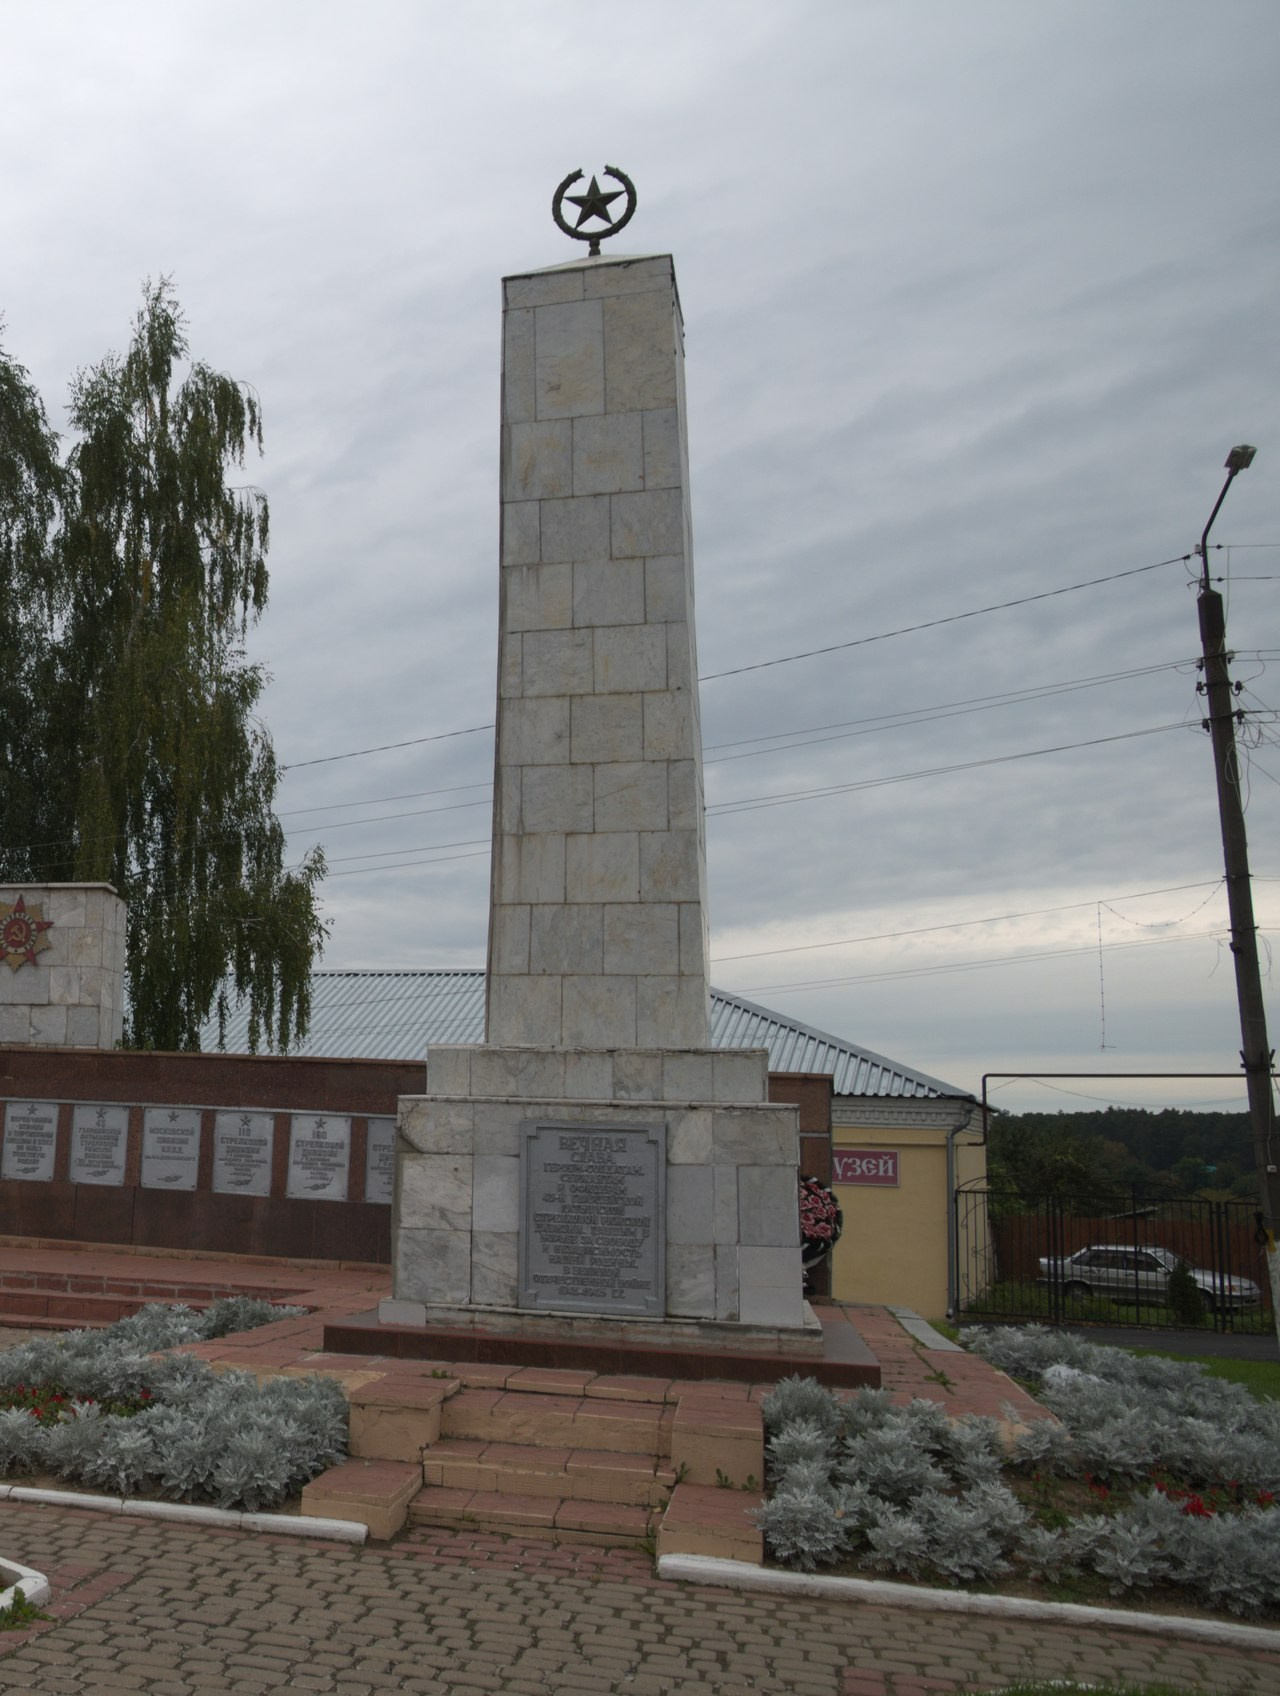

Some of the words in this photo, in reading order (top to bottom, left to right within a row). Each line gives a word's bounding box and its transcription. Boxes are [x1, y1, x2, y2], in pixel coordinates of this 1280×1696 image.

[559, 1136, 627, 1152] ВЕЧНАЯ
[571, 1152, 616, 1164] СЛАВА
[832, 1154, 895, 1180] УЗЕЙ
